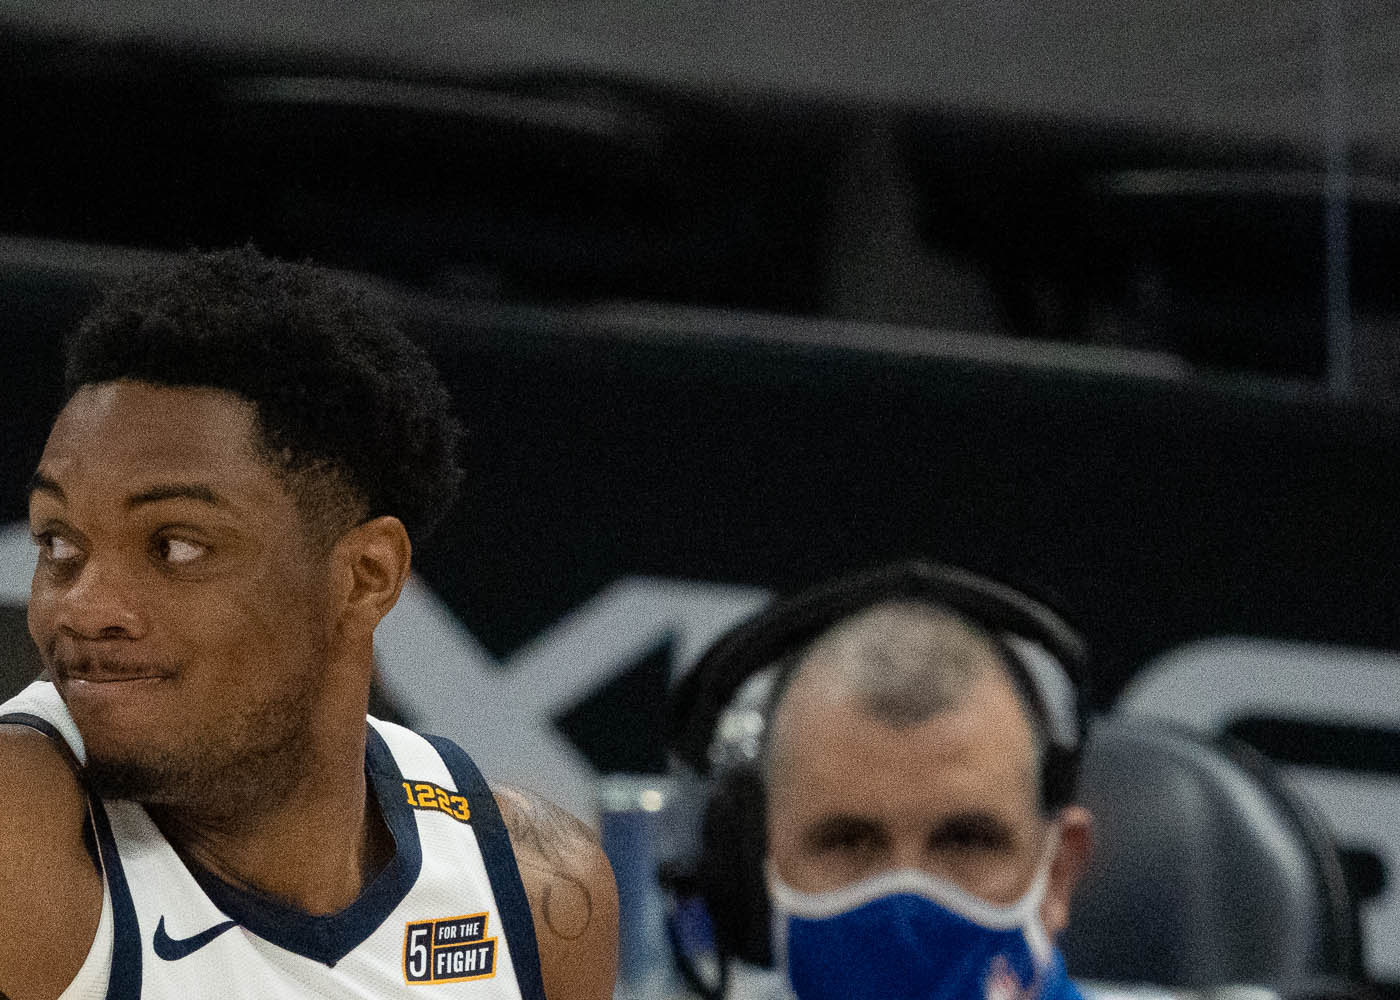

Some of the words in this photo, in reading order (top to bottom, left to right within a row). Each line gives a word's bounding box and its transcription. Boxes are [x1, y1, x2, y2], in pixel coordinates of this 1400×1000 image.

[402, 782, 471, 821] 1223
[438, 925, 457, 940] FOR
[460, 922, 480, 937] THE
[409, 929, 427, 978] 5
[436, 947, 489, 975] FIGHT
